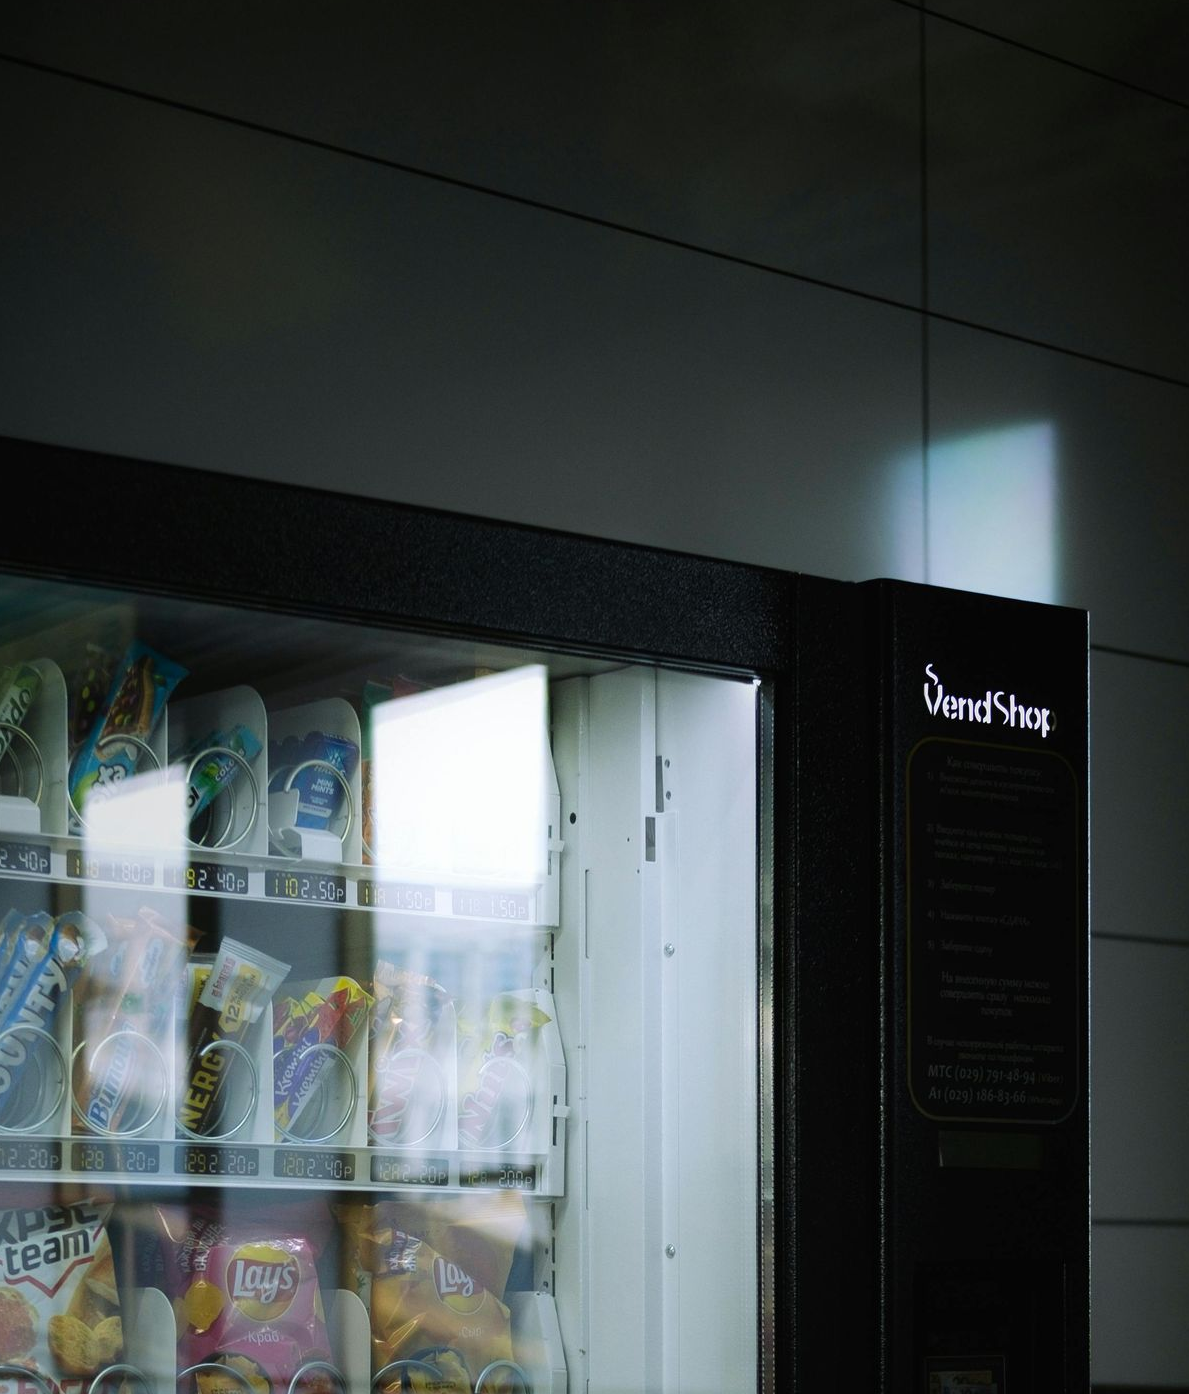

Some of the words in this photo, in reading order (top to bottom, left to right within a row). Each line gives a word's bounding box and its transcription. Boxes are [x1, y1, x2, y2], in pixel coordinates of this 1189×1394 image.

[923, 664, 1057, 738] VendShop
[944, 1085, 973, 1104] (029)
[976, 1086, 1027, 1106] 186-83-66
[954, 1063, 984, 1083] (029)
[5, 1229, 90, 1275] team
[233, 1259, 296, 1304] Lay's
